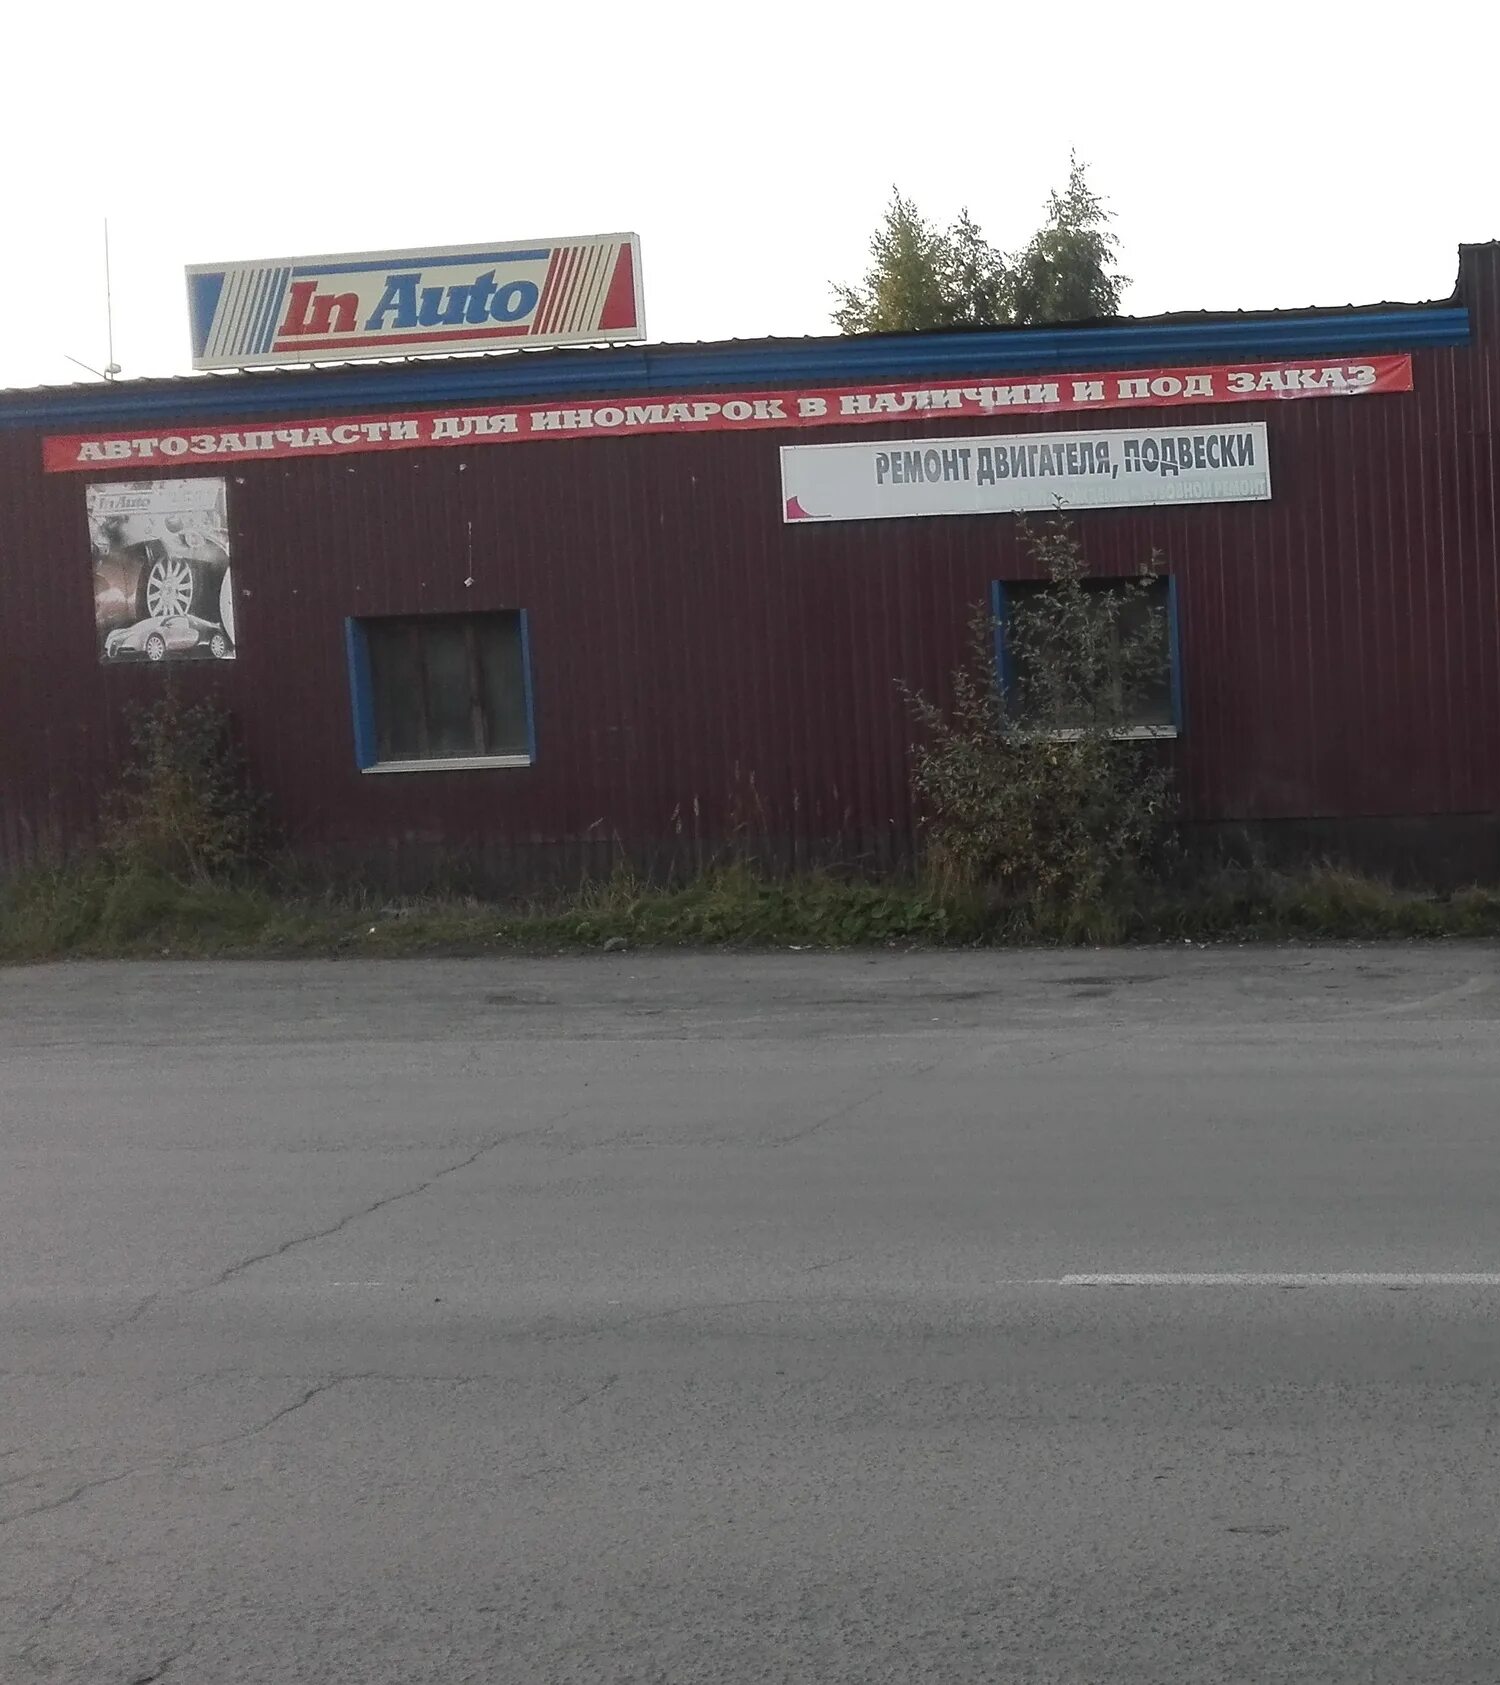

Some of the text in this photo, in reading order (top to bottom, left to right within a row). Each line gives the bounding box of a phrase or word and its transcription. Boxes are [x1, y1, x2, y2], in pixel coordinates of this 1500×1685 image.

[277, 268, 540, 337] In Auto
[76, 365, 1377, 462] АВТОЗАПЧАСТИ ДЛЯ ИНОМАРОК В НАЛИЧИИ И ПОД ЗАКАЗ
[875, 433, 1255, 486] РЕМОНТ ДВИГАТЕЛЯ, ПОДВЕСКИ
